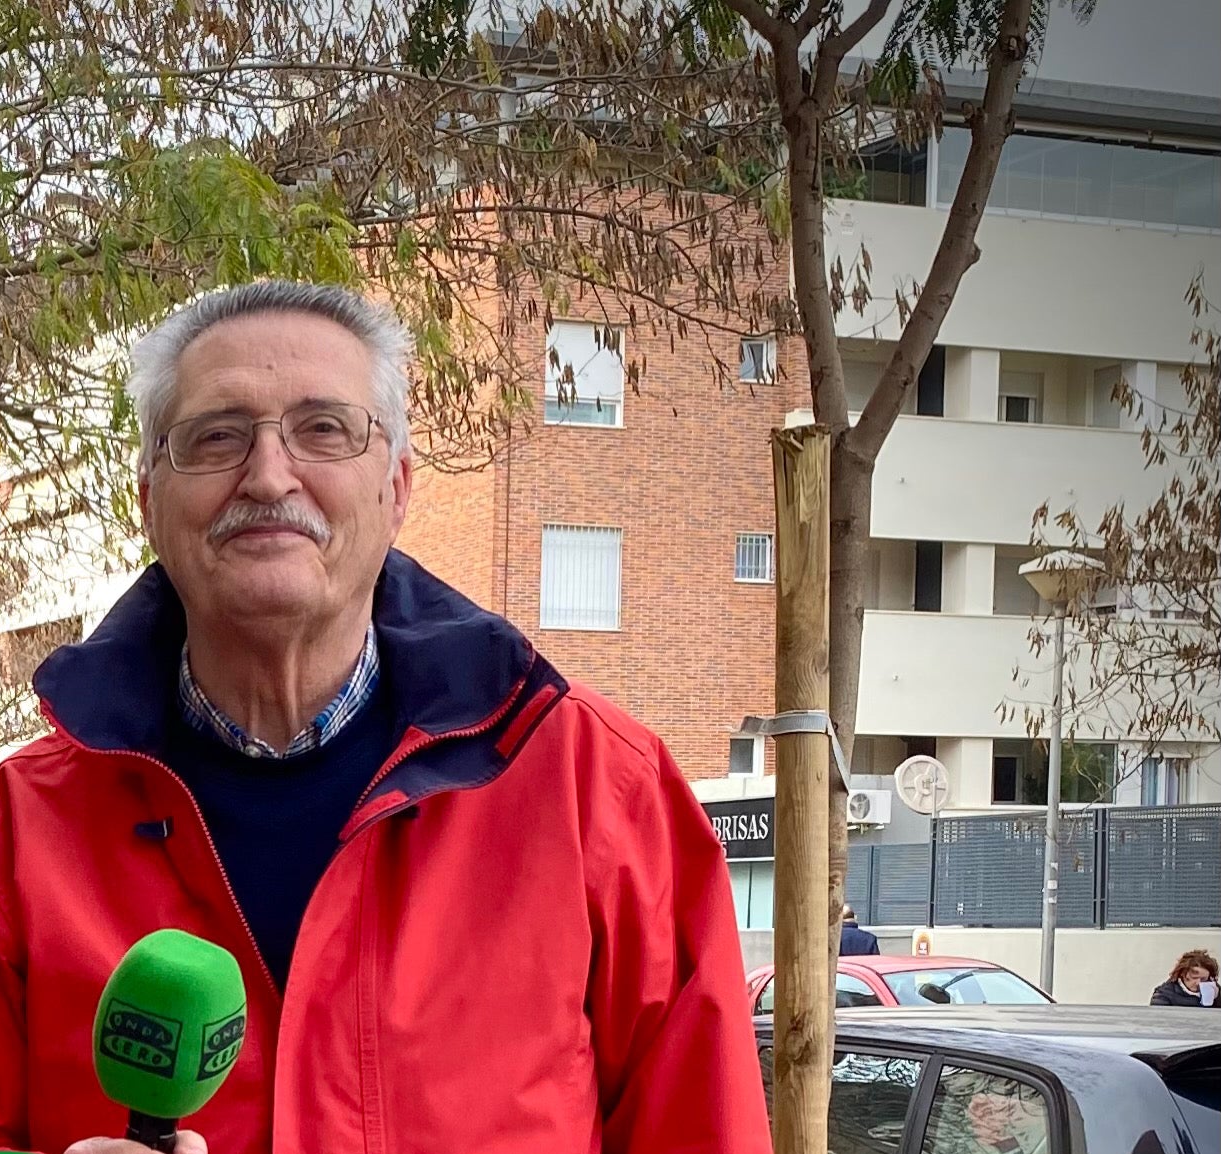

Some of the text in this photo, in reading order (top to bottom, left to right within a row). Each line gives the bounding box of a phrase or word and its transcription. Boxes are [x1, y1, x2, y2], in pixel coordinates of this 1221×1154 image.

[711, 813, 769, 841] BRISAS
[114, 1014, 166, 1042] ONDA
[111, 1037, 163, 1065] CERO
